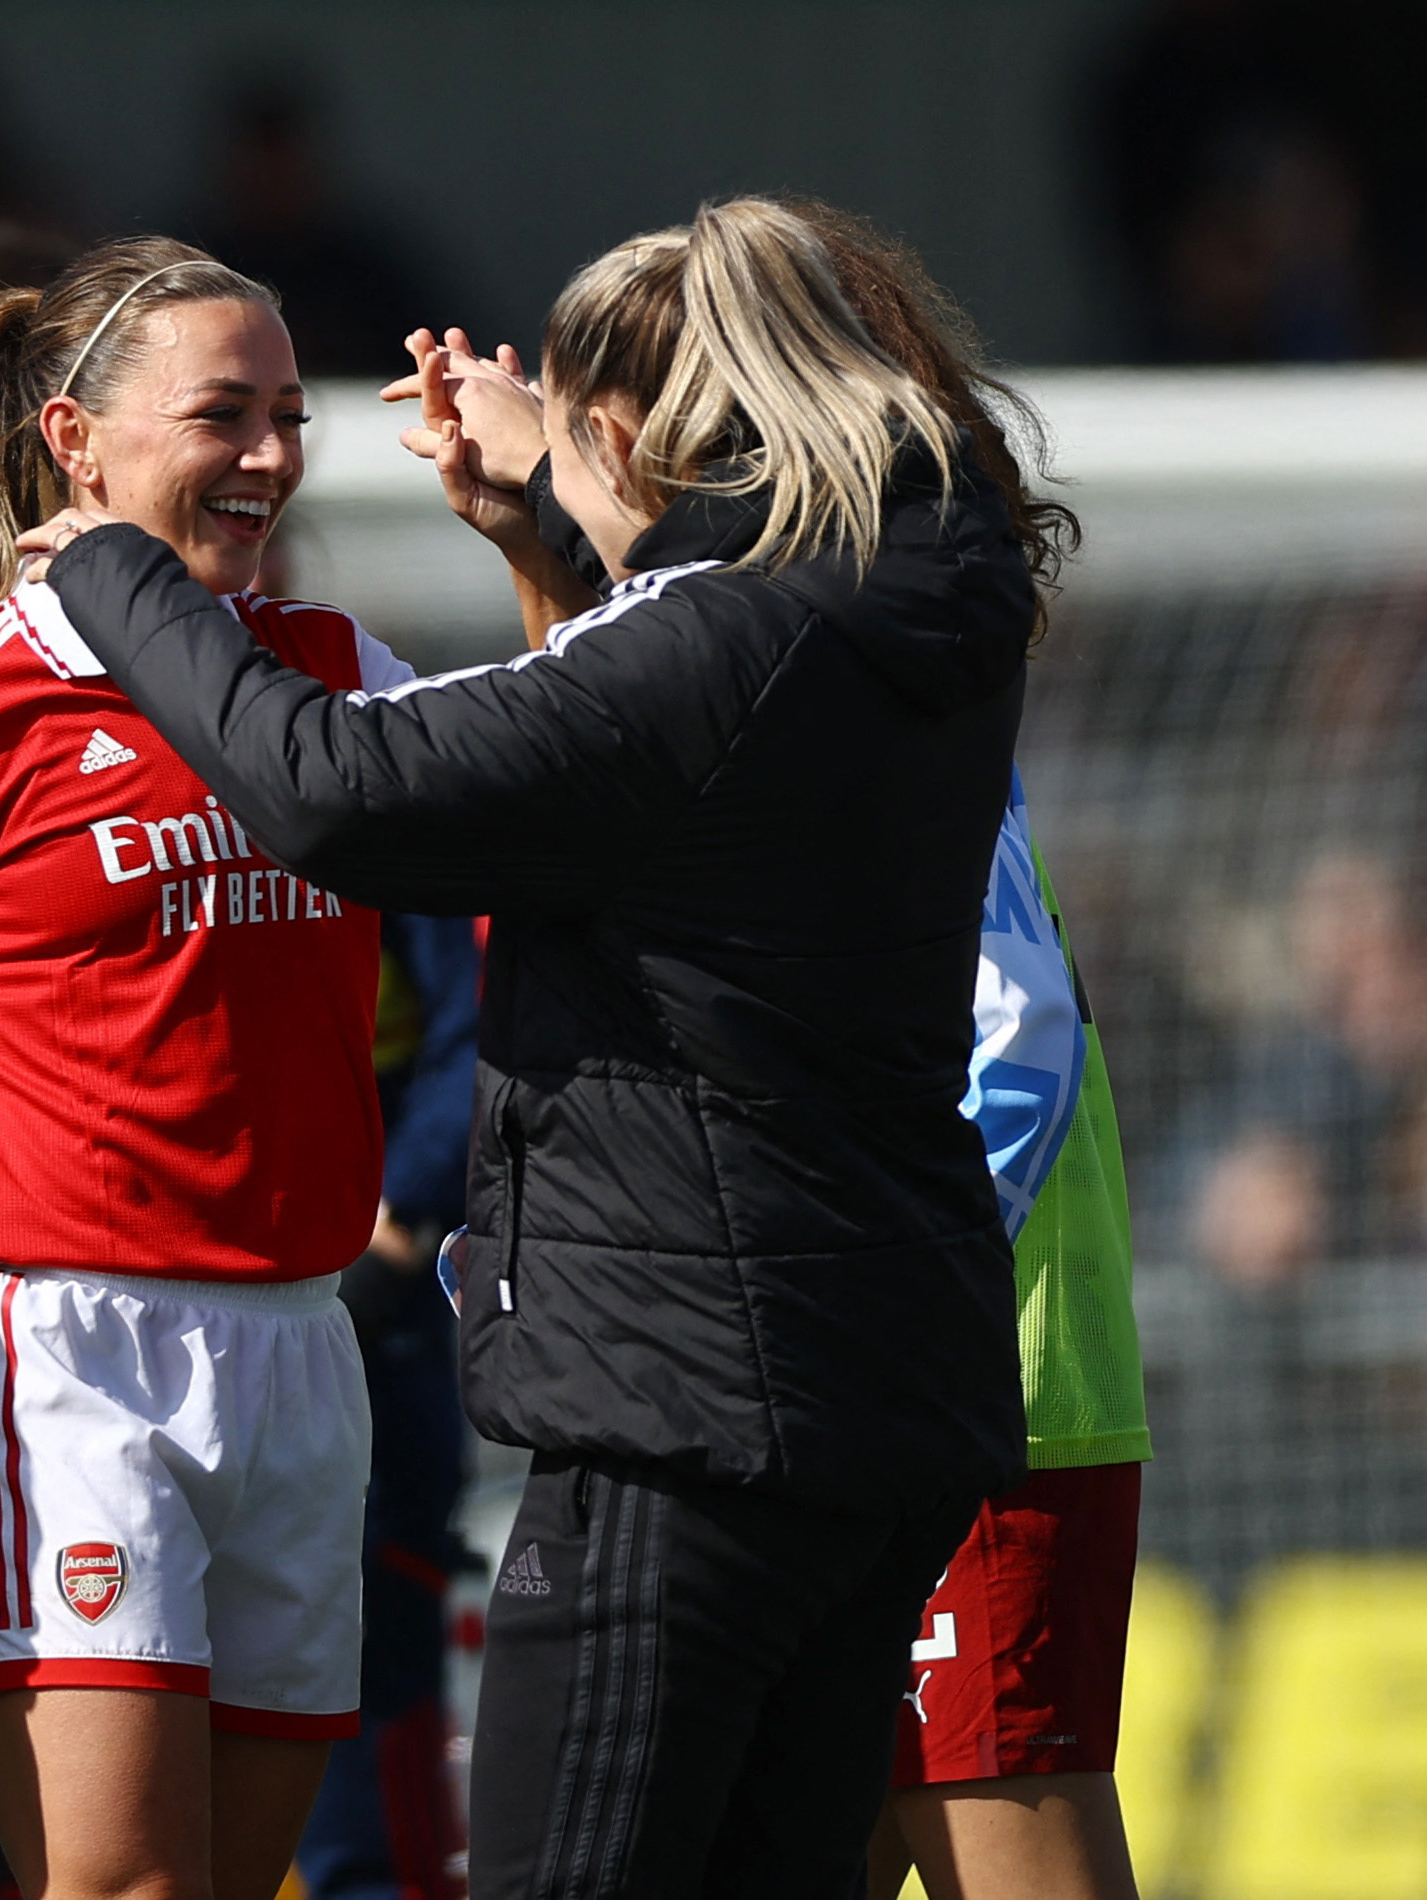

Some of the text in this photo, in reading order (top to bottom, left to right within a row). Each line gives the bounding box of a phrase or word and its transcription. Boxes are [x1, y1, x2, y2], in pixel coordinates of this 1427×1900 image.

[79, 748, 137, 774] adidas
[89, 794, 253, 884] Emir
[161, 868, 342, 937] FLY BETTER
[64, 1554, 117, 1569] Arsenal
[500, 1575, 551, 1596] adidas
